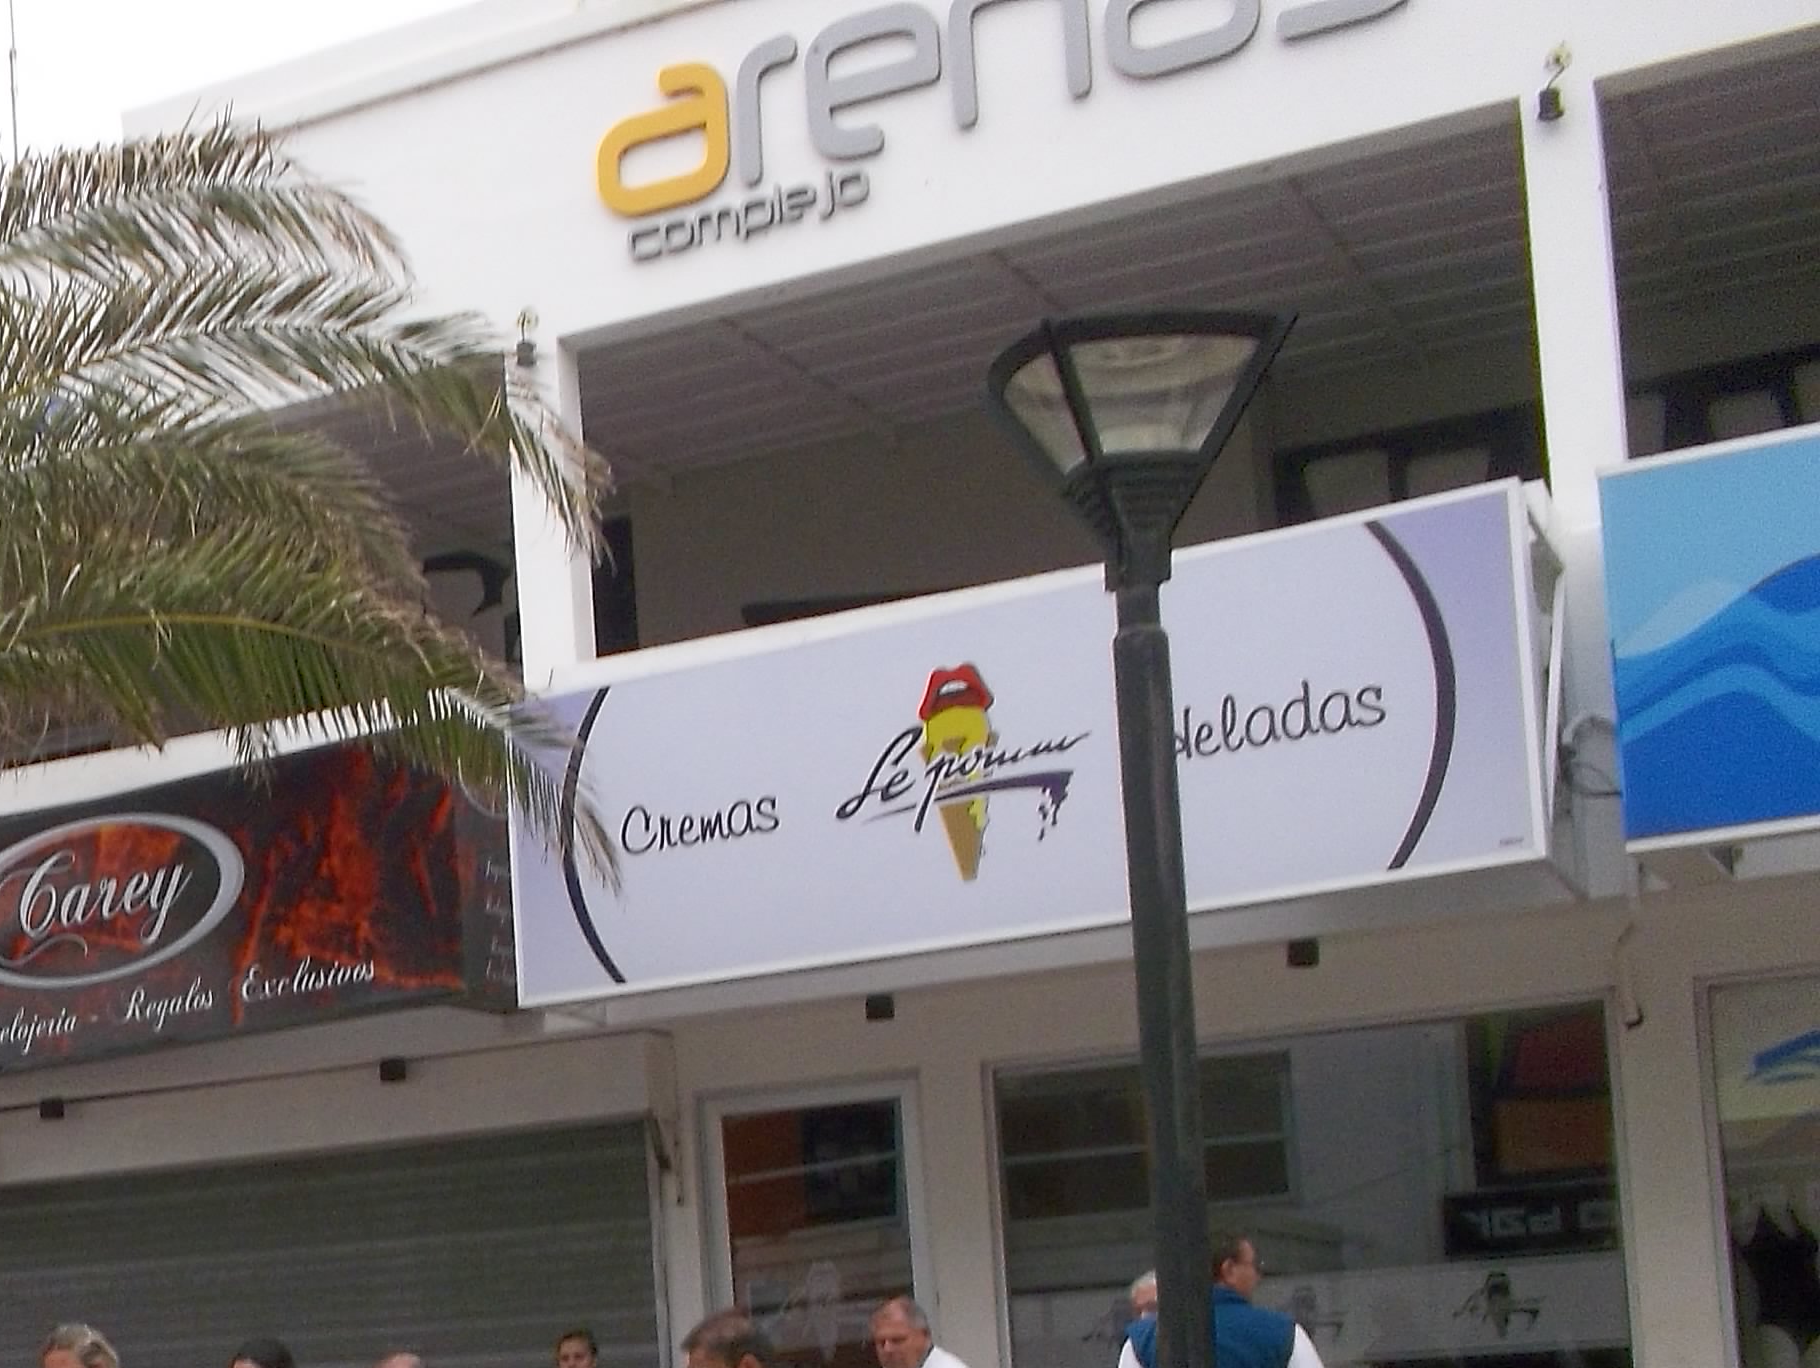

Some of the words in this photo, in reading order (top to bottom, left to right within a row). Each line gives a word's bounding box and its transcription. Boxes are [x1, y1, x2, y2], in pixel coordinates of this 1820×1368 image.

[596, 0, 1412, 217] aren
[627, 169, 871, 263] complejo
[621, 795, 780, 857] Cremas
[124, 976, 213, 1033] Regalos
[242, 956, 375, 1002] Exclusivos
